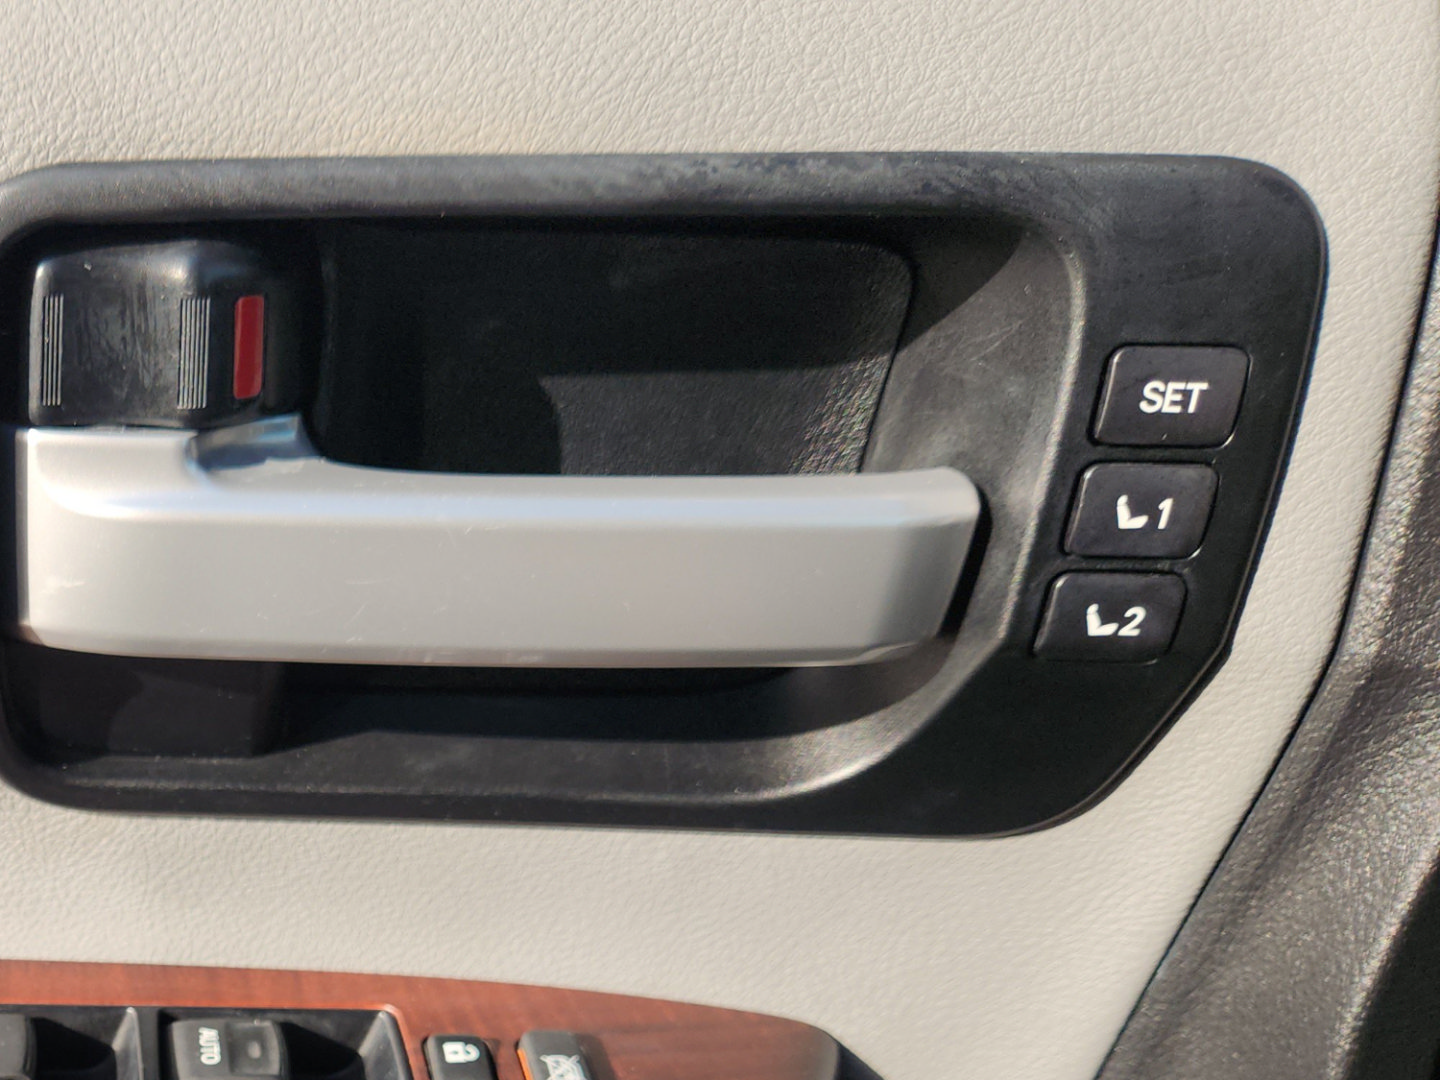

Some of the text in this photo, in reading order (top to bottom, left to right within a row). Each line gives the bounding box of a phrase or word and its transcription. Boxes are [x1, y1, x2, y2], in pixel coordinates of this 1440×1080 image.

[1139, 380, 1209, 414] SET
[1158, 498, 1173, 530] 1
[1117, 606, 1147, 637] 2
[198, 1026, 222, 1066] AUTO
